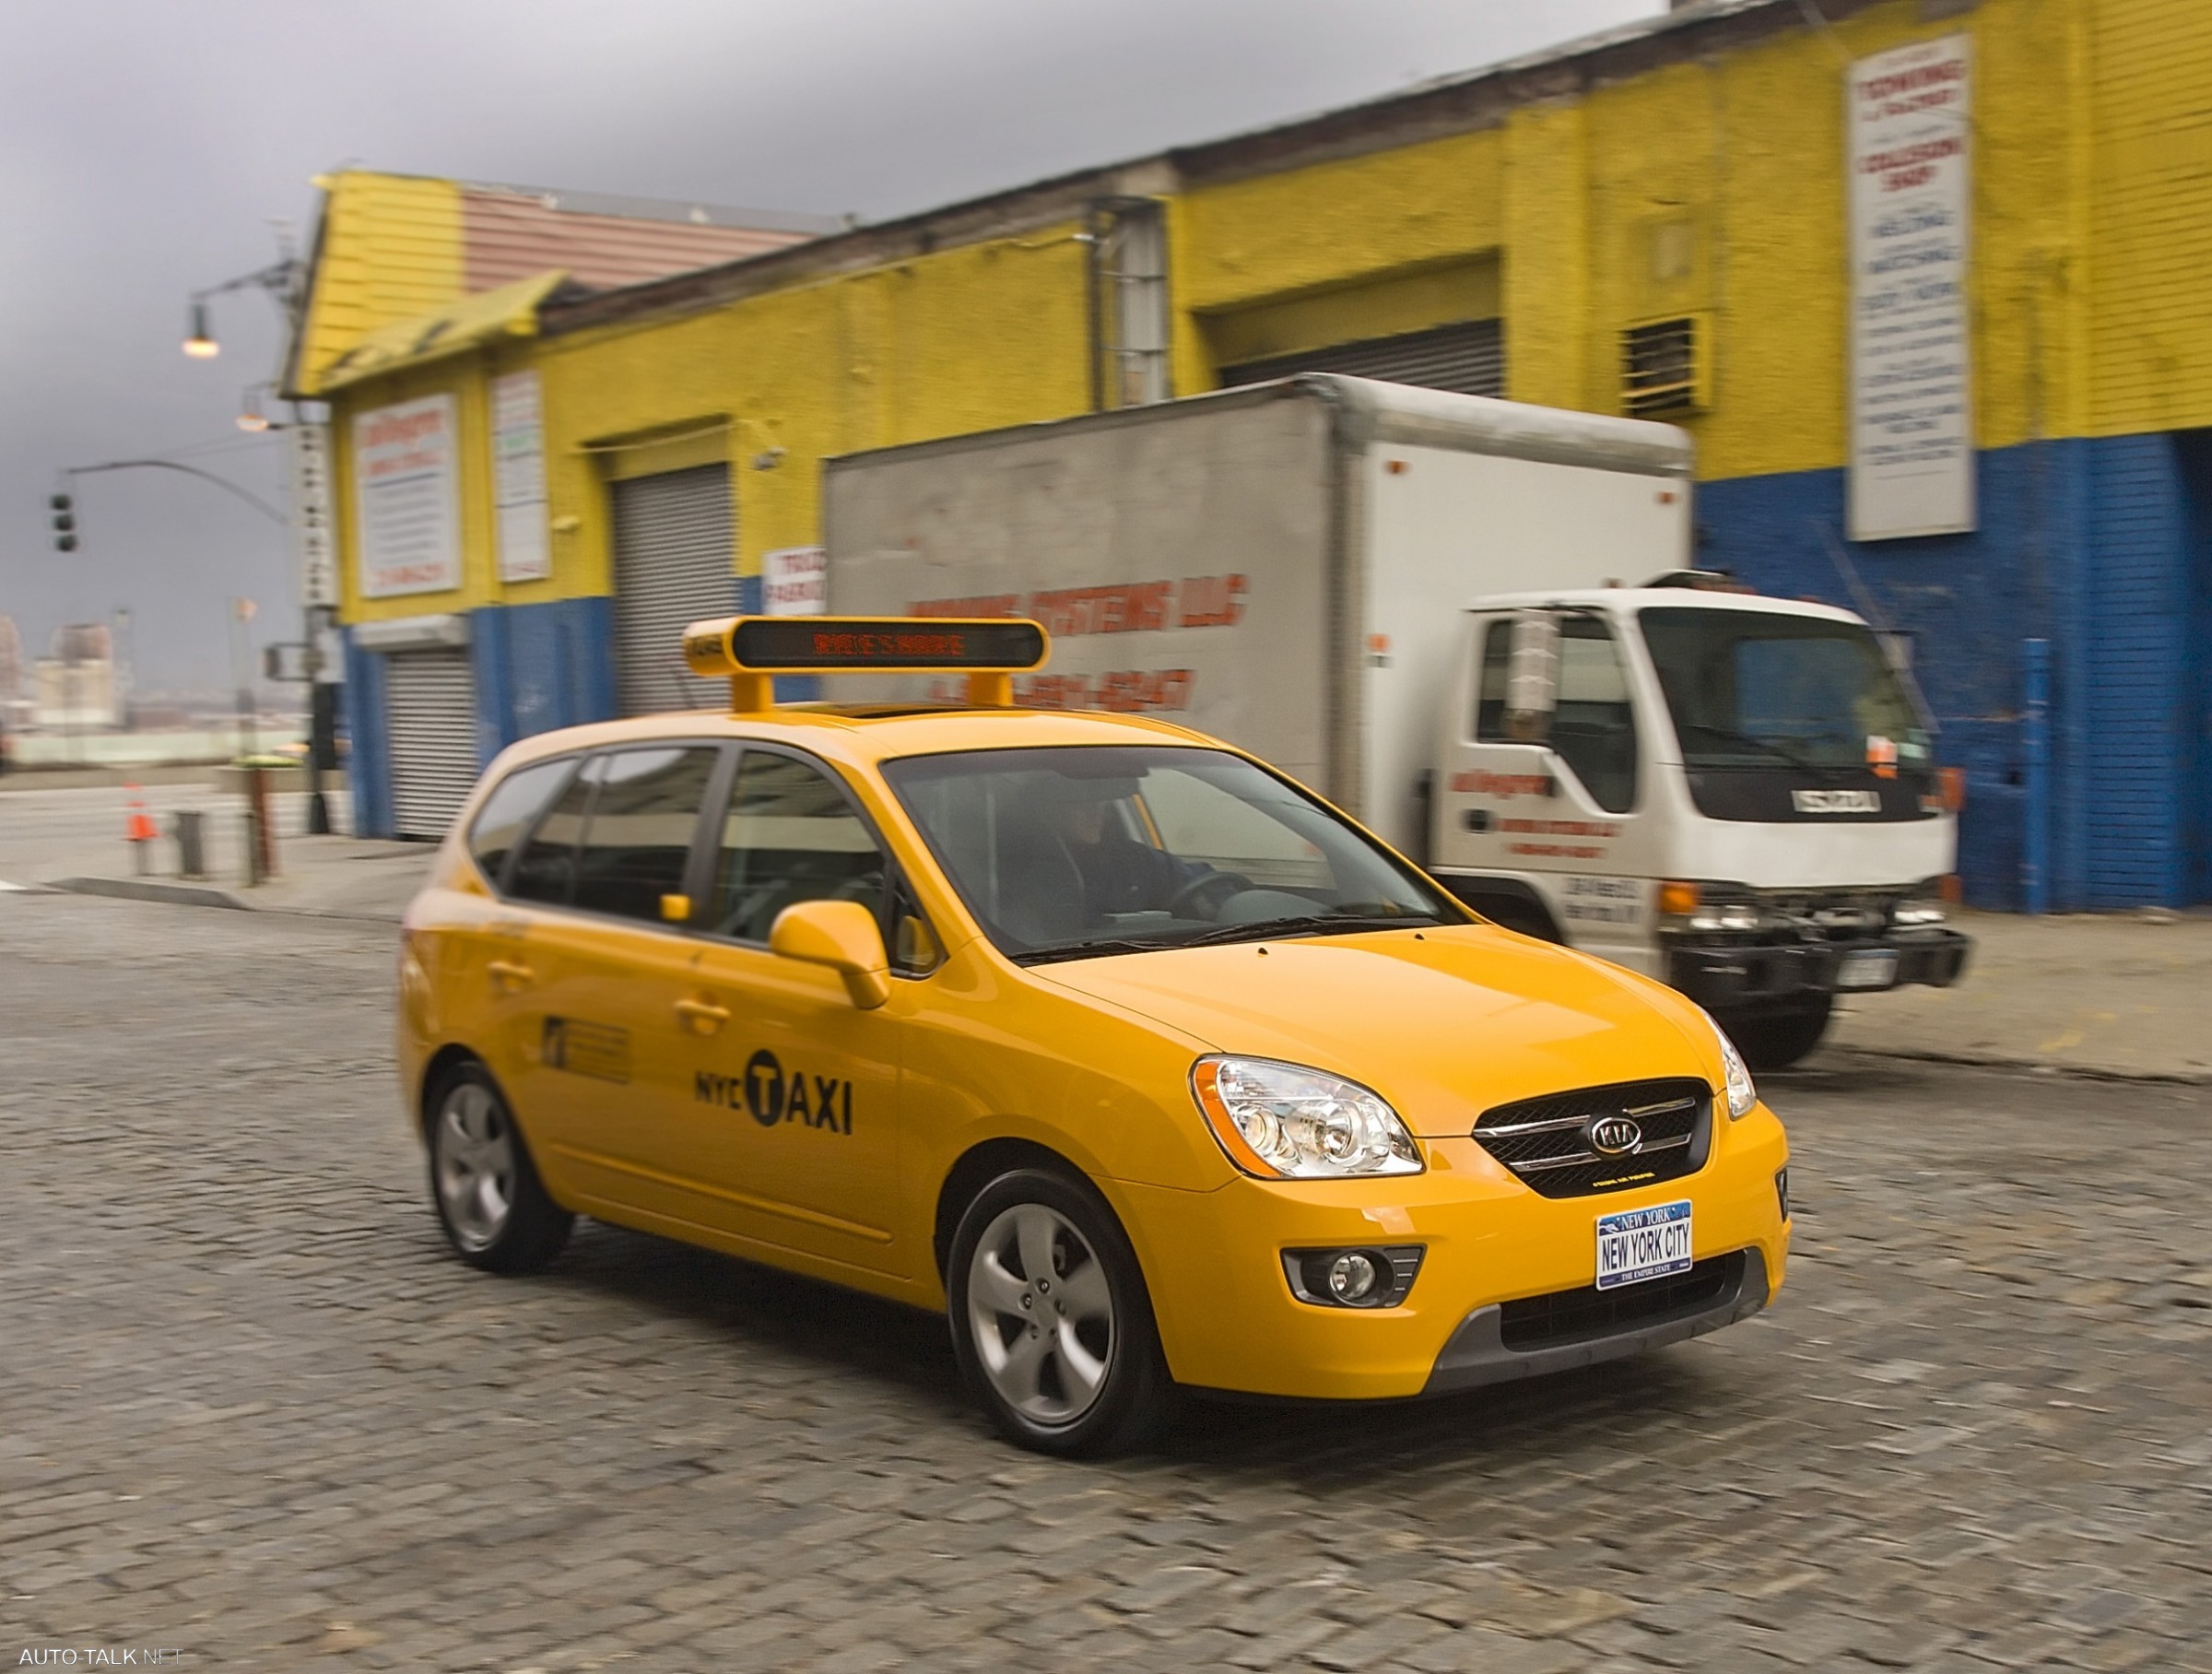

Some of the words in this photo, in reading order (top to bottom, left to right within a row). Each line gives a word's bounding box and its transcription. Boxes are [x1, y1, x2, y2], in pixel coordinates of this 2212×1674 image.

[745, 1049, 853, 1137] TAXI
[1620, 1214, 1644, 1231] NEW
[1645, 1208, 1671, 1225] YORK
[1602, 1235, 1629, 1272] NEW
[1630, 1228, 1663, 1266] YORK
[1665, 1222, 1689, 1258] CITY
[1621, 1272, 1633, 1281] THE
[1633, 1267, 1653, 1279] EMPIRE
[1654, 1264, 1671, 1274] STATE
